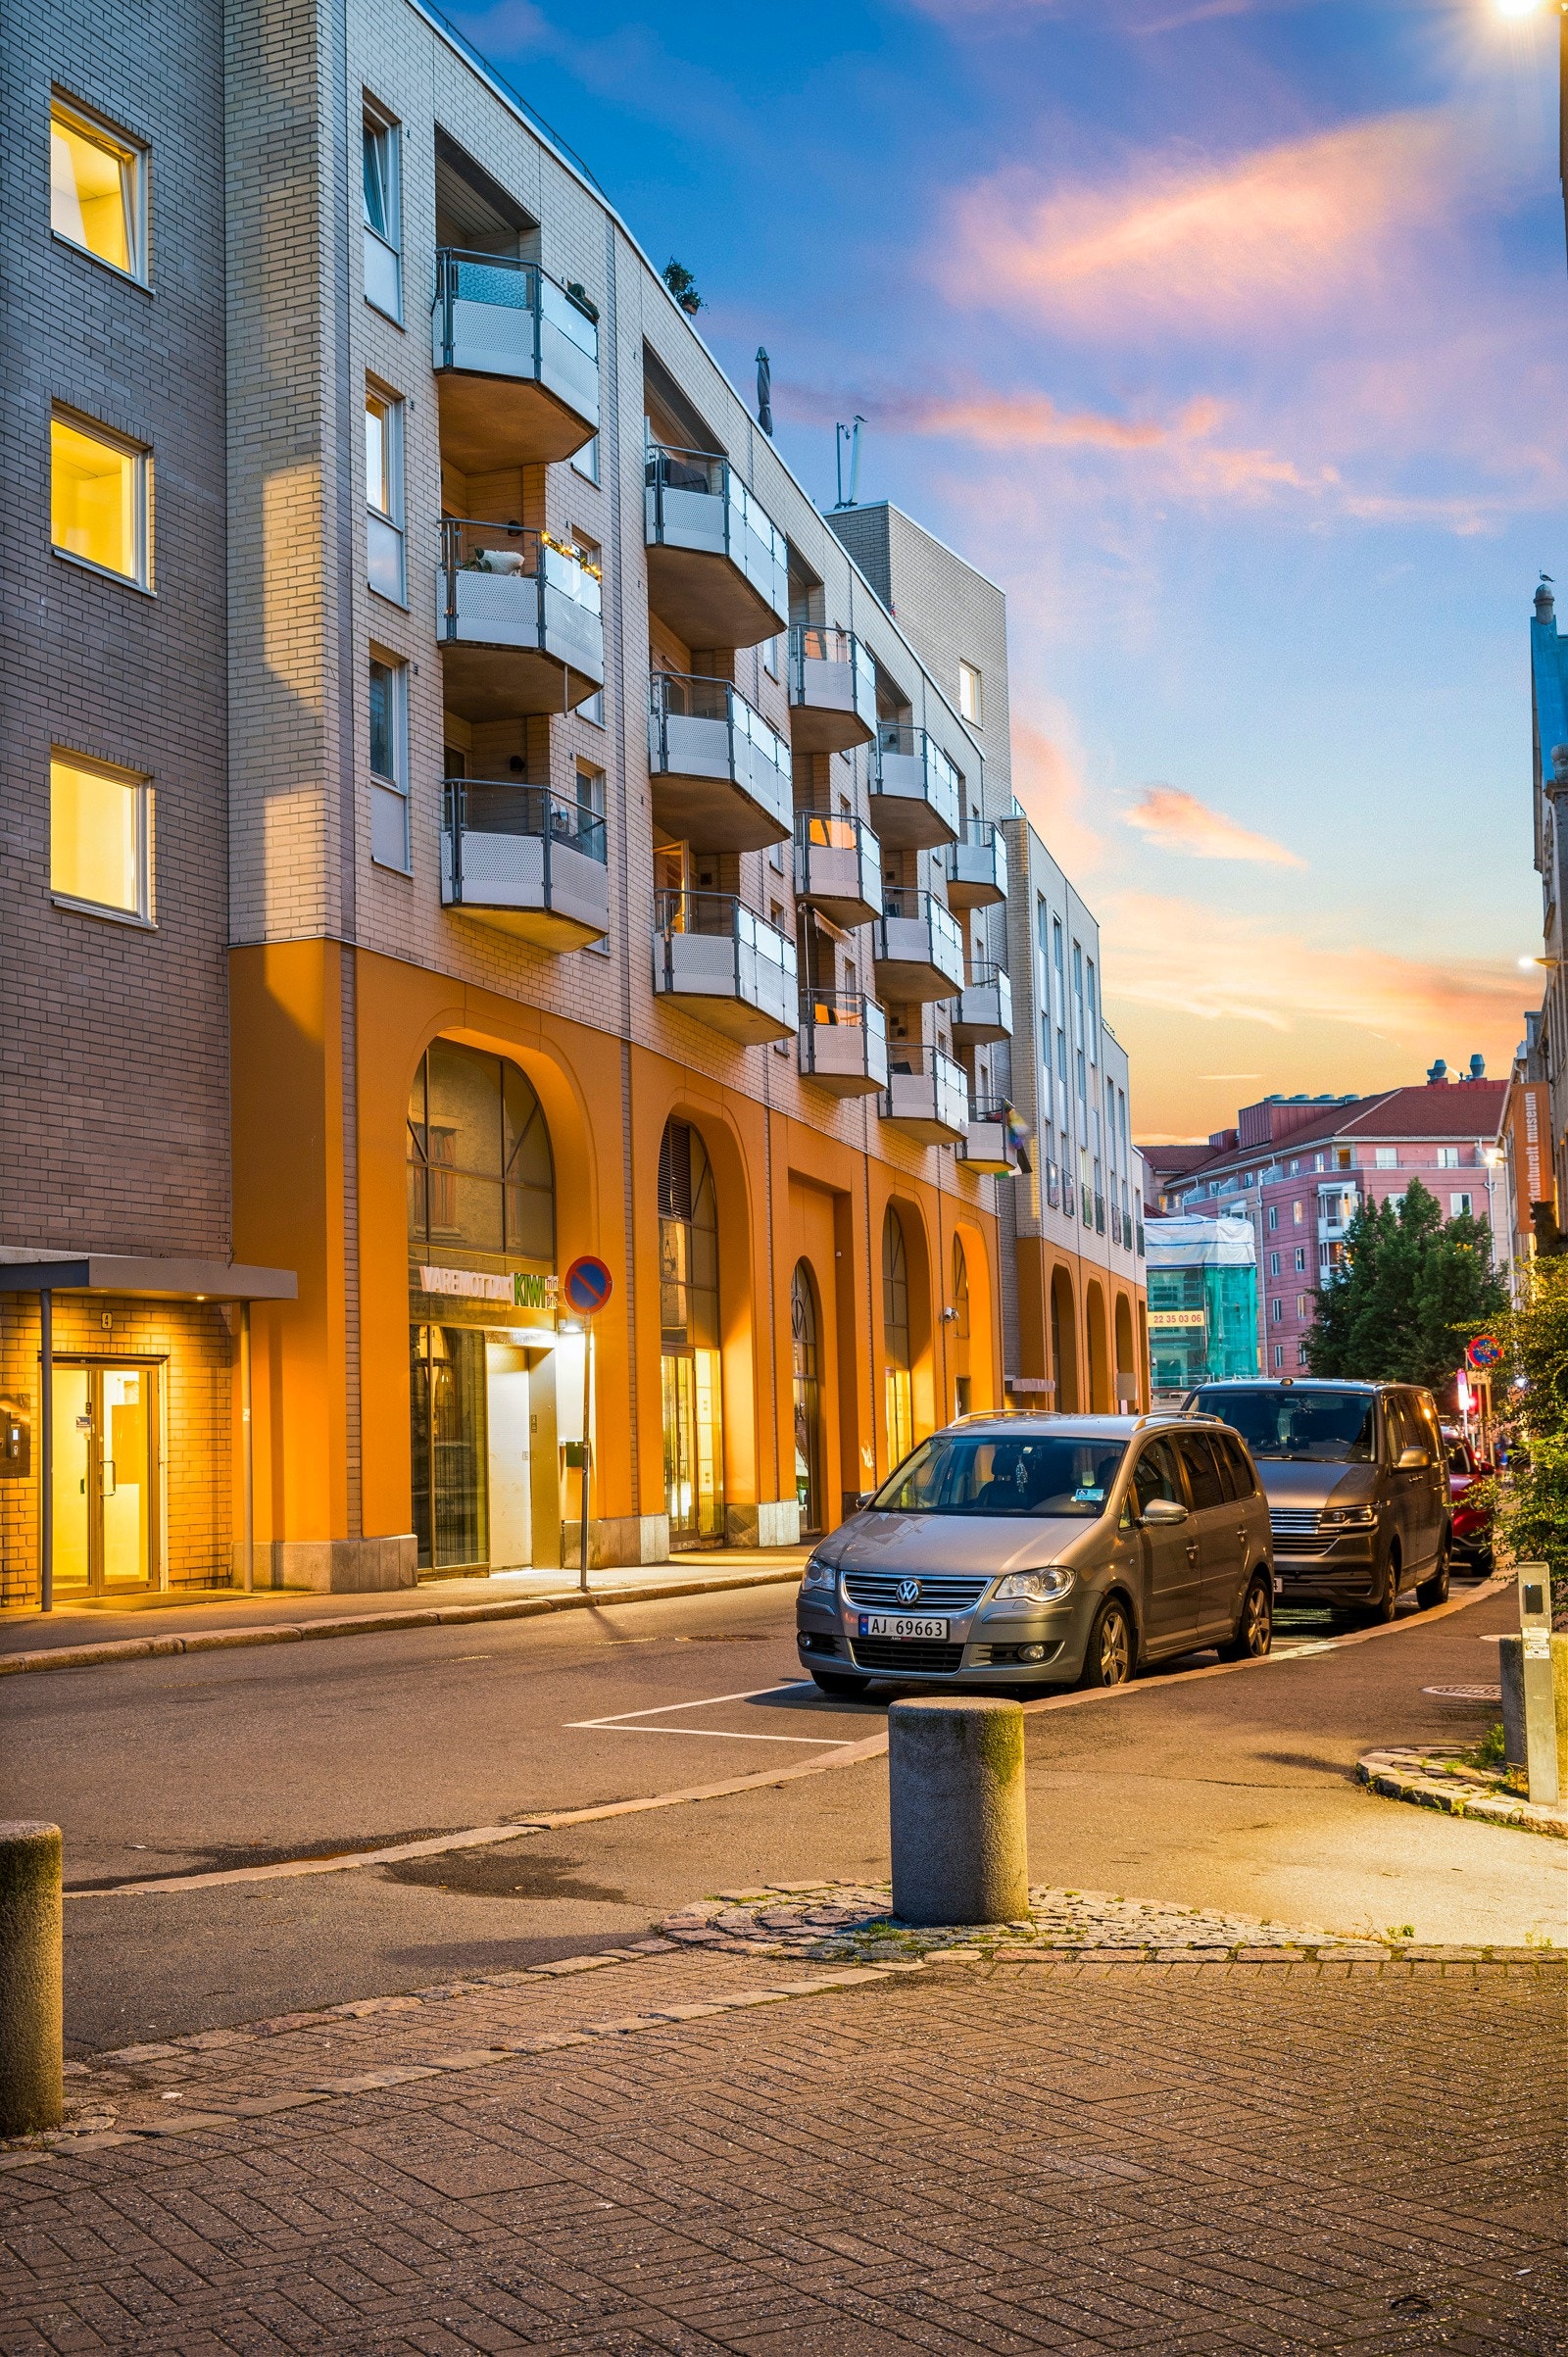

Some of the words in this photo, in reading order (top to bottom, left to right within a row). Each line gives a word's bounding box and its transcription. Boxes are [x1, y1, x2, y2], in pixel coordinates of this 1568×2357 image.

[1525, 1092, 1538, 1143] museum
[1526, 1146, 1542, 1224] rkulturelt
[514, 1273, 546, 1309] KIWI
[1166, 1314, 1177, 1323] 35
[1179, 1314, 1189, 1323] 03
[1192, 1314, 1201, 1323] 06
[871, 1618, 887, 1634] AJ
[896, 1620, 943, 1637] 69663
